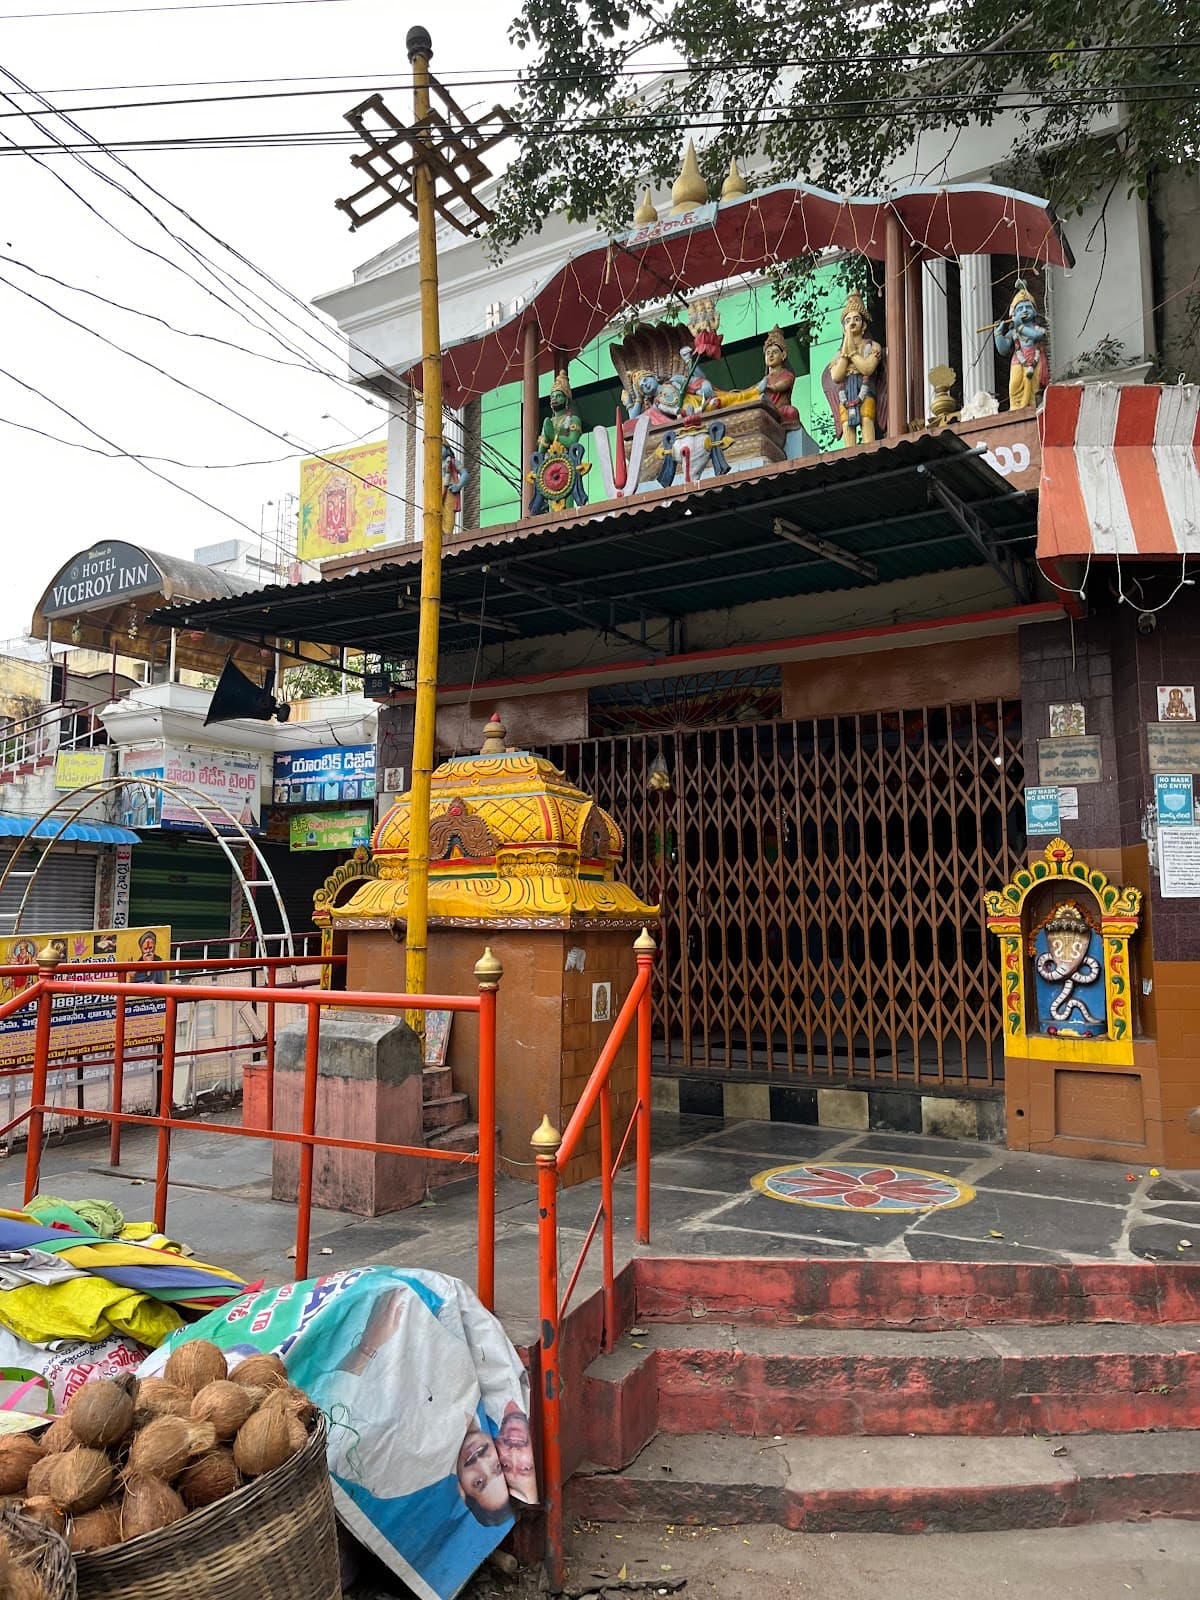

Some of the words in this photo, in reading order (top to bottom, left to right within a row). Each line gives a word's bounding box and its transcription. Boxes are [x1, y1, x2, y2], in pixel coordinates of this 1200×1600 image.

[82, 557, 117, 578] HOTEL
[52, 573, 115, 608] VICEROY
[118, 563, 150, 590] INN
[166, 767, 196, 783] బాబు
